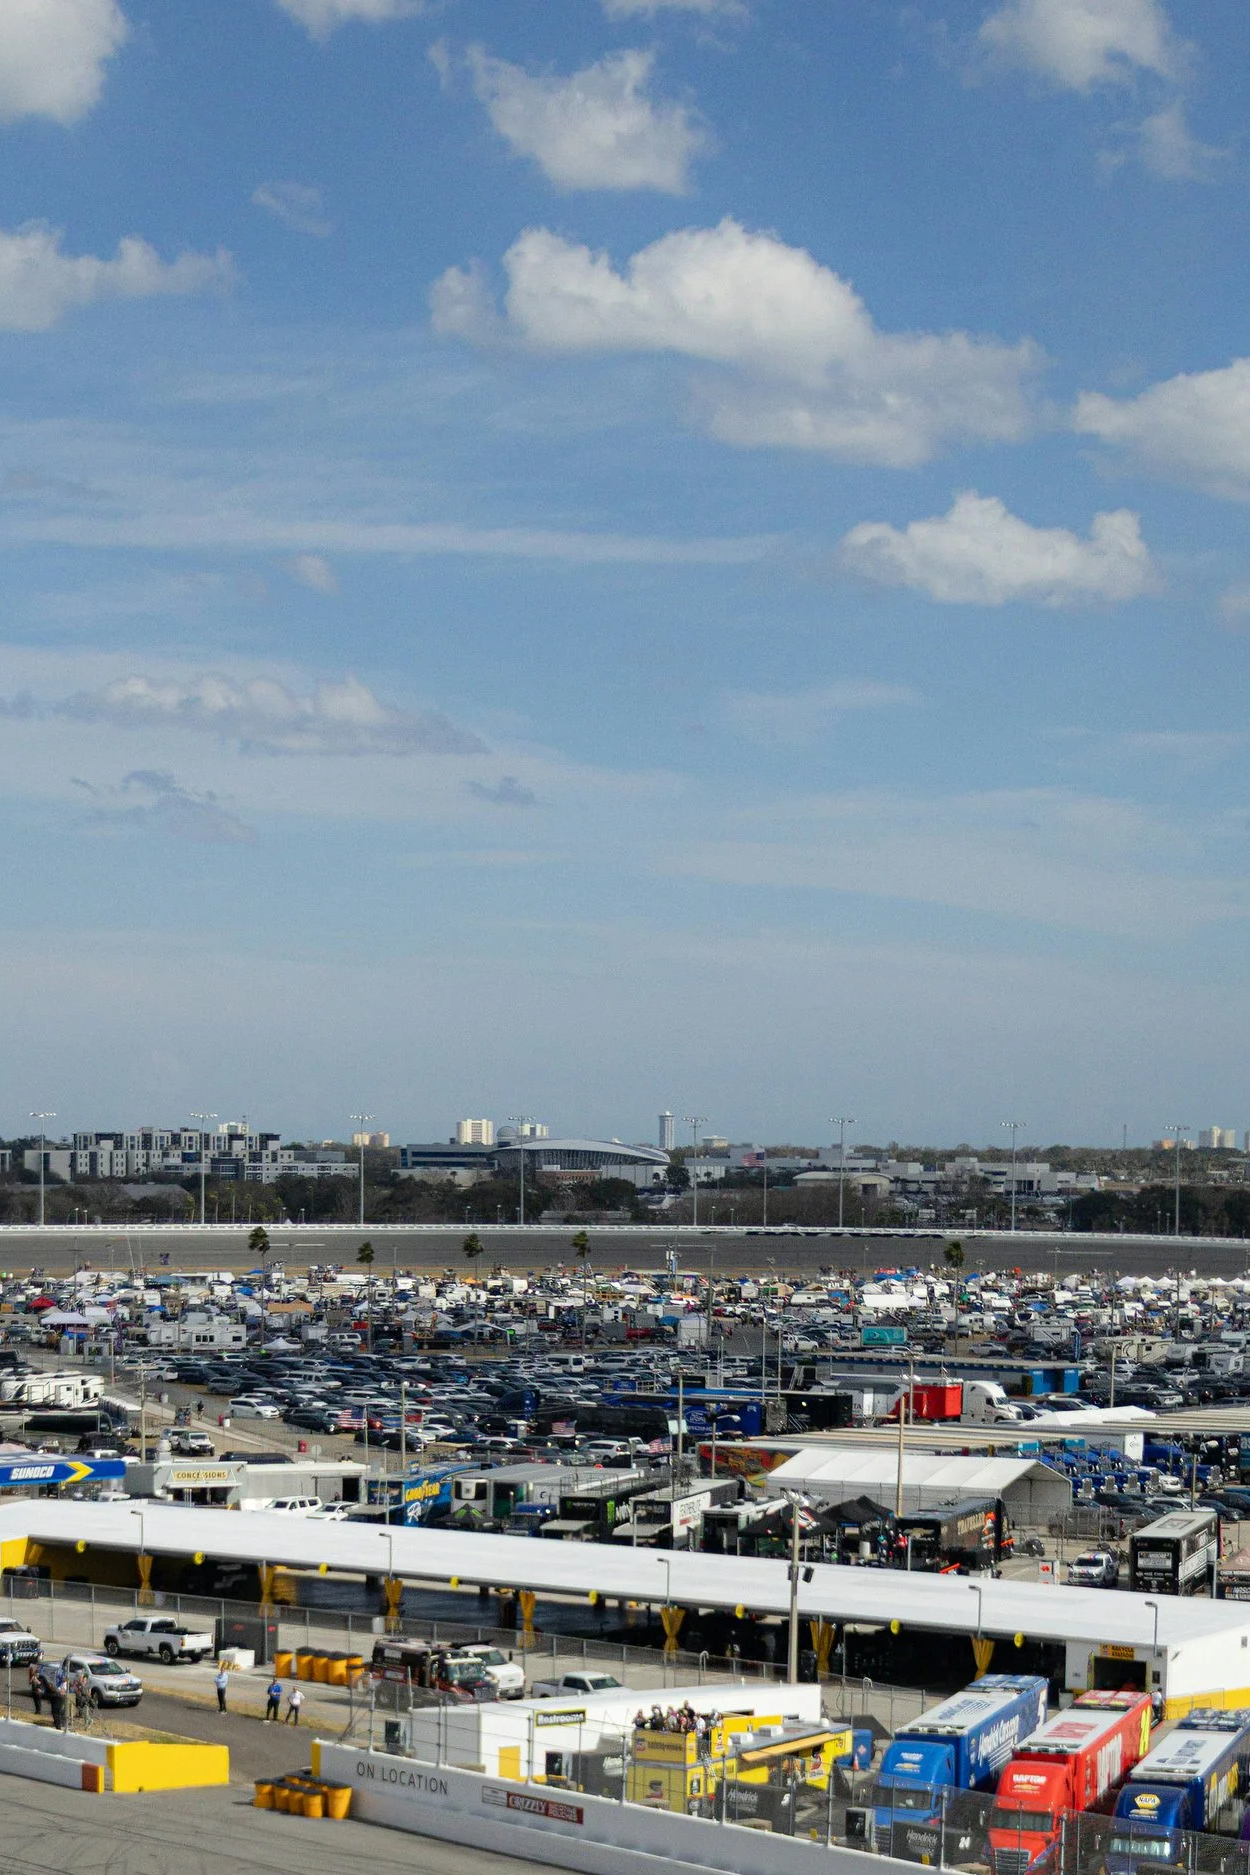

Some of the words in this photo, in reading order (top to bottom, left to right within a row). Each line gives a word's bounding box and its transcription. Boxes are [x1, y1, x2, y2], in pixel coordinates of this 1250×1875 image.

[10, 1465, 55, 1480] SUNOCO
[537, 1713, 584, 1724] Restrooms
[356, 1760, 376, 1780] ON
[381, 1767, 449, 1795] LOCATION
[1012, 1774, 1048, 1784] RAPTOR
[728, 1787, 759, 1802] Hendrick
[1138, 1796, 1157, 1804] NAPA
[508, 1795, 548, 1815] GRIZZLY
[906, 1828, 938, 1845] Hendrick
